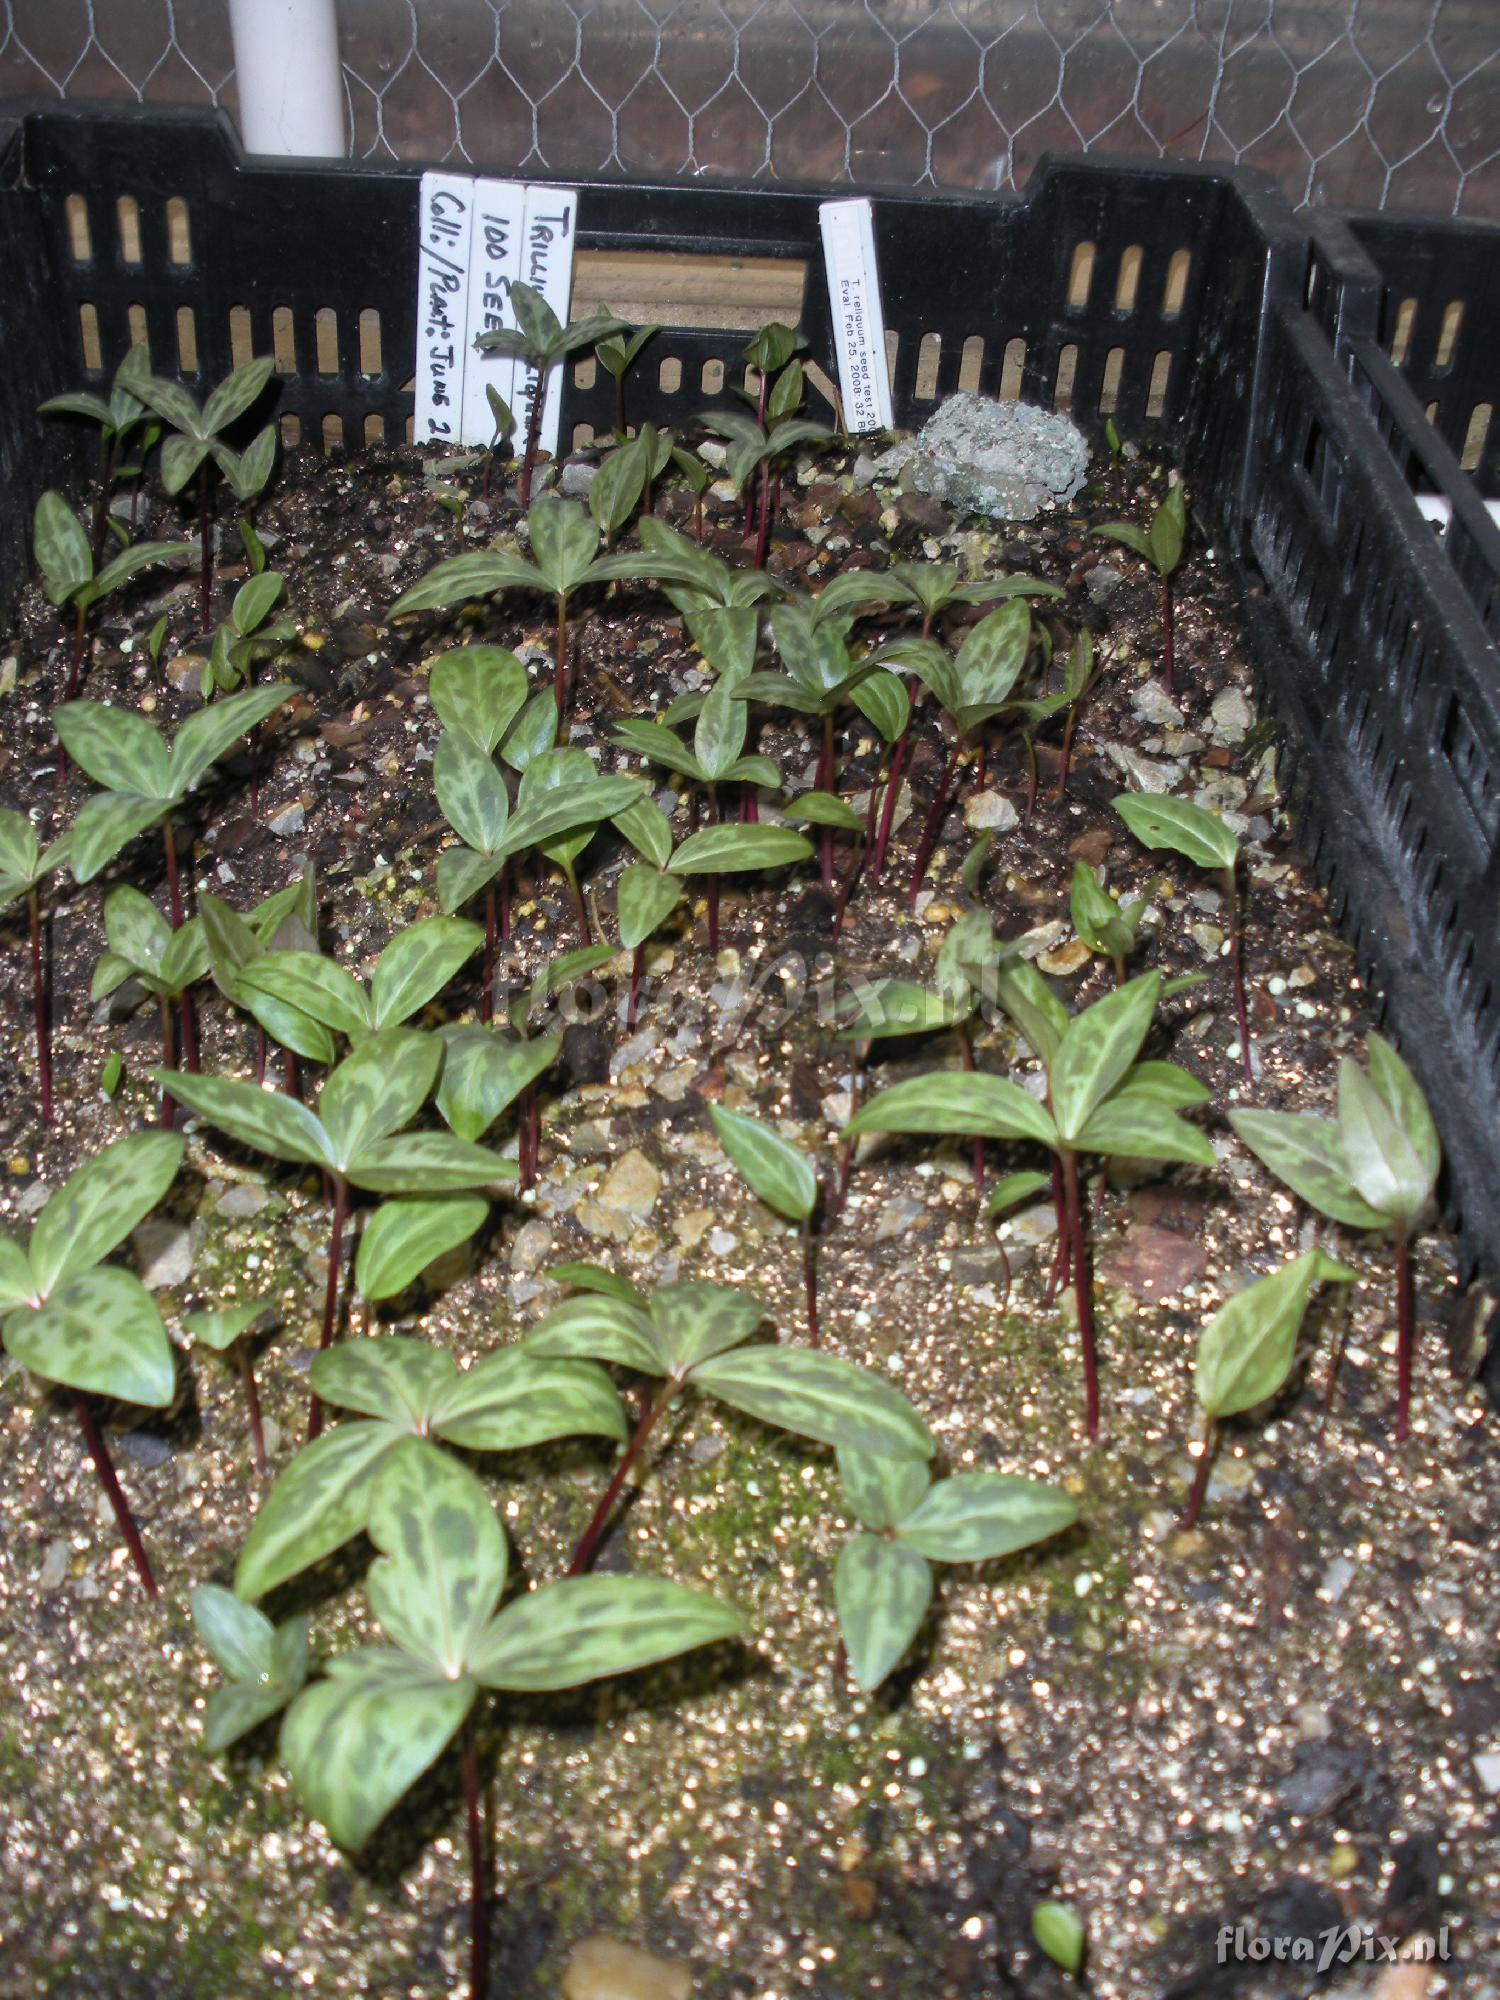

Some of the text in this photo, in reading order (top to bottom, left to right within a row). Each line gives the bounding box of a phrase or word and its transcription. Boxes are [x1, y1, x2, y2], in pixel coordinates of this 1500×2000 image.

[481, 213, 511, 330] 100 SEE
[845, 314, 854, 337] Feb
[855, 402, 865, 417] 32
[860, 351, 870, 379] seed
[864, 385, 873, 408] test
[428, 417, 451, 435] 2
[867, 412, 876, 432] 200
